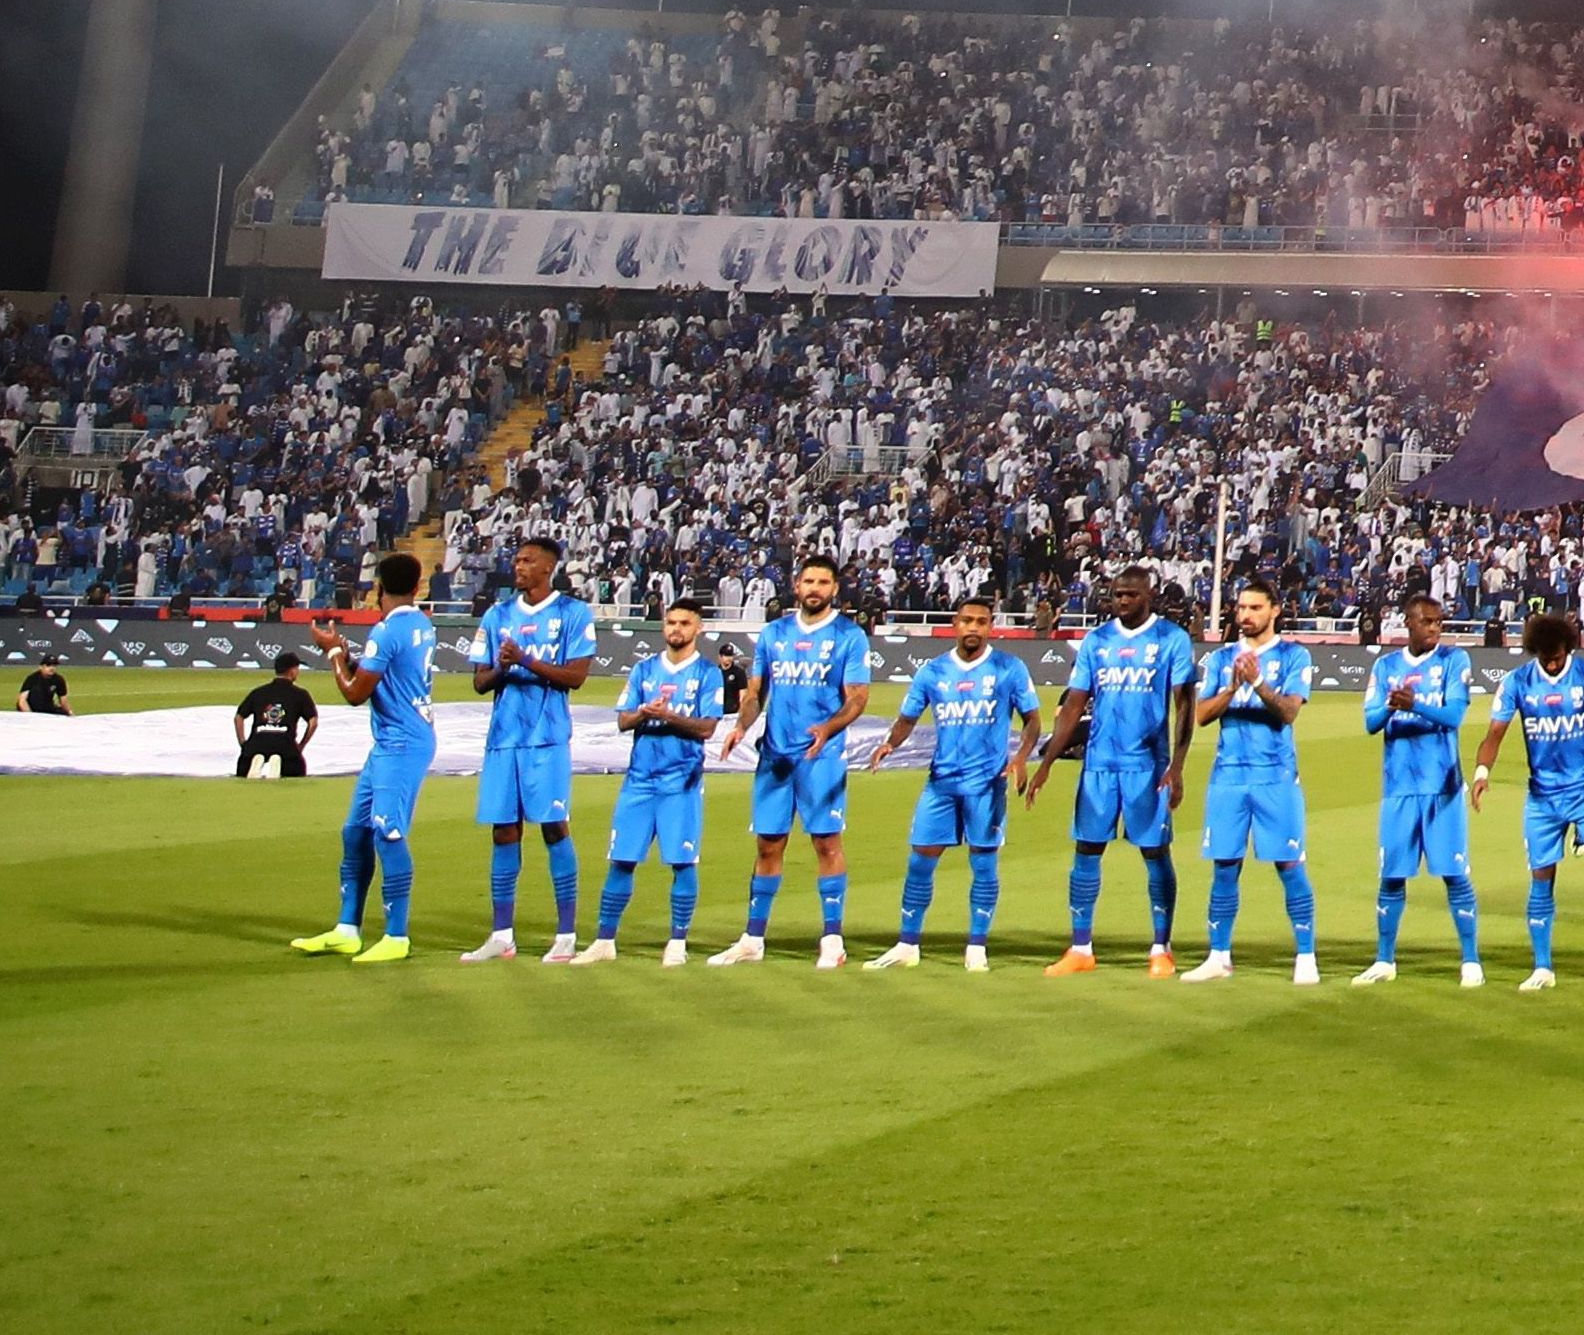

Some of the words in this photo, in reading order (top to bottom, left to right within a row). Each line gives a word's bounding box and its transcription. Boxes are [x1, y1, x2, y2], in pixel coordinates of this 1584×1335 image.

[402, 211, 520, 276] THE
[719, 221, 929, 287] GLORY
[771, 660, 832, 679] SAVVY
[1097, 666, 1157, 685] SAVVY
[936, 699, 997, 719] SAVVY
